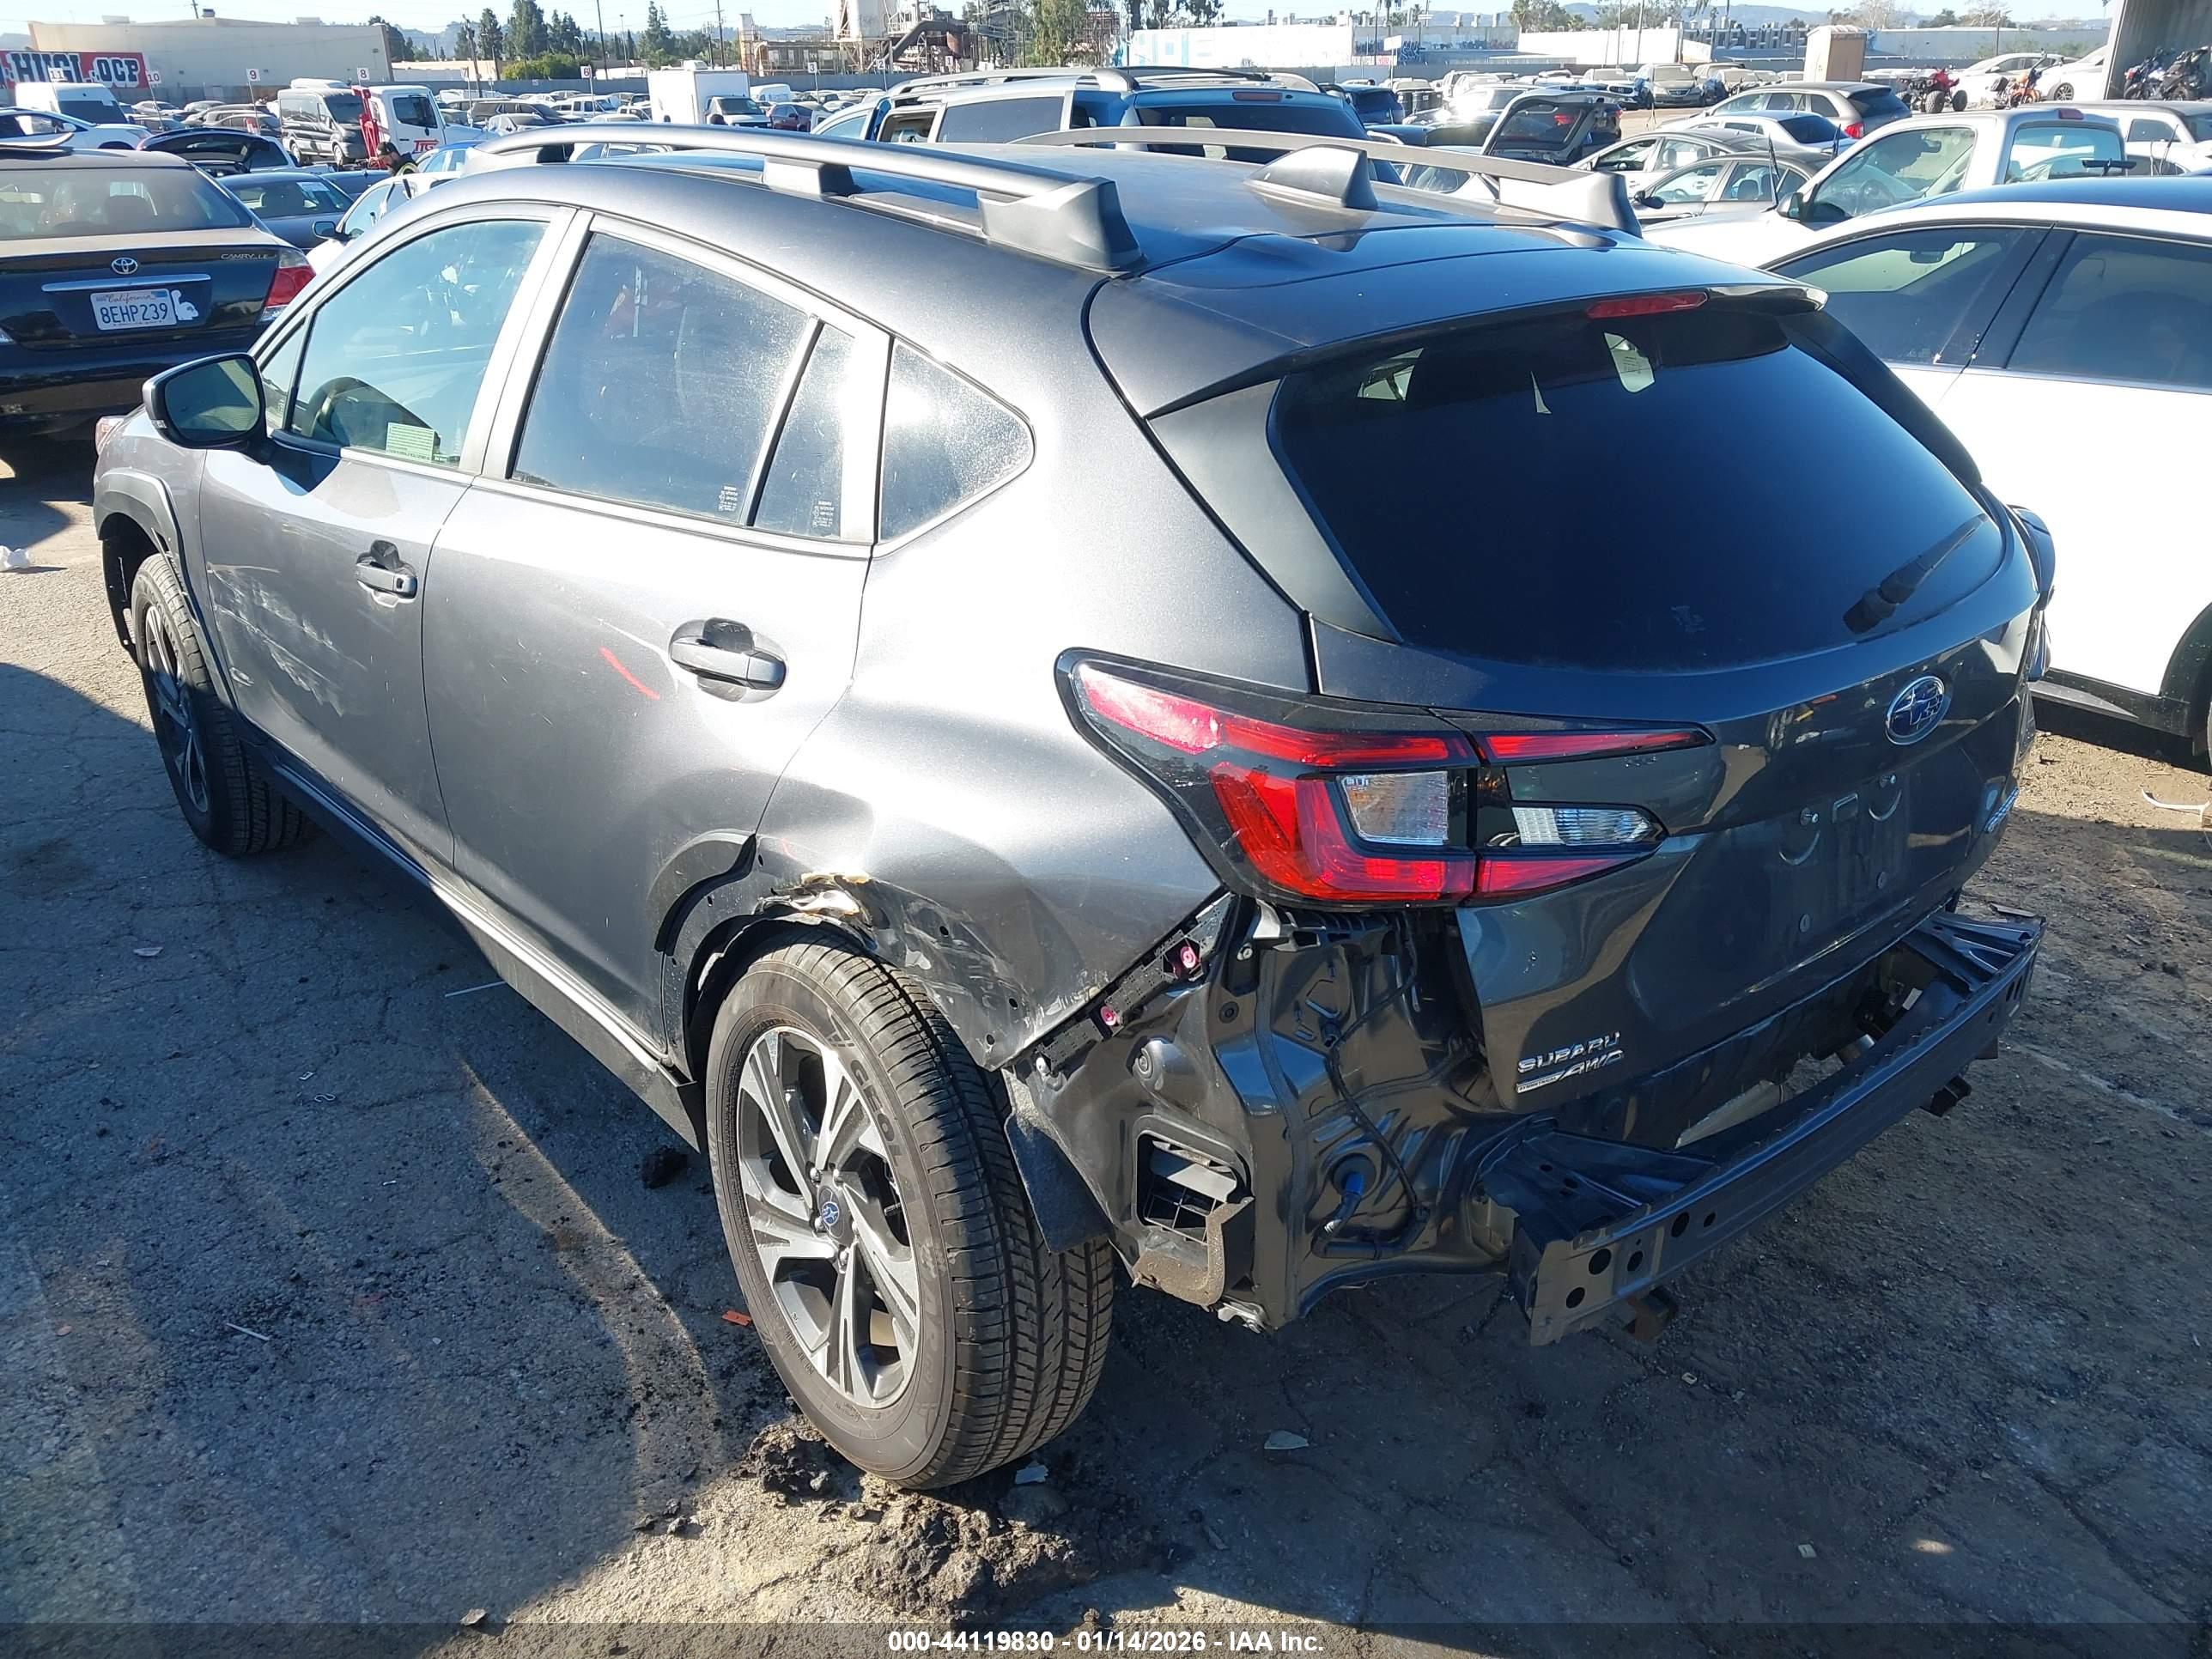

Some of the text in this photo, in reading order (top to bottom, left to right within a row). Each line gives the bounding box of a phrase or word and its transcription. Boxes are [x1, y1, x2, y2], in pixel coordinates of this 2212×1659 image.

[809, 64, 815, 72] 3
[50, 70, 64, 80] 11
[148, 73, 161, 82] 10
[249, 70, 257, 80] 9
[360, 70, 368, 79] 8
[108, 292, 152, 304] California
[100, 302, 168, 324] 8EHP239
[1517, 1030, 1621, 1073] SUBARU
